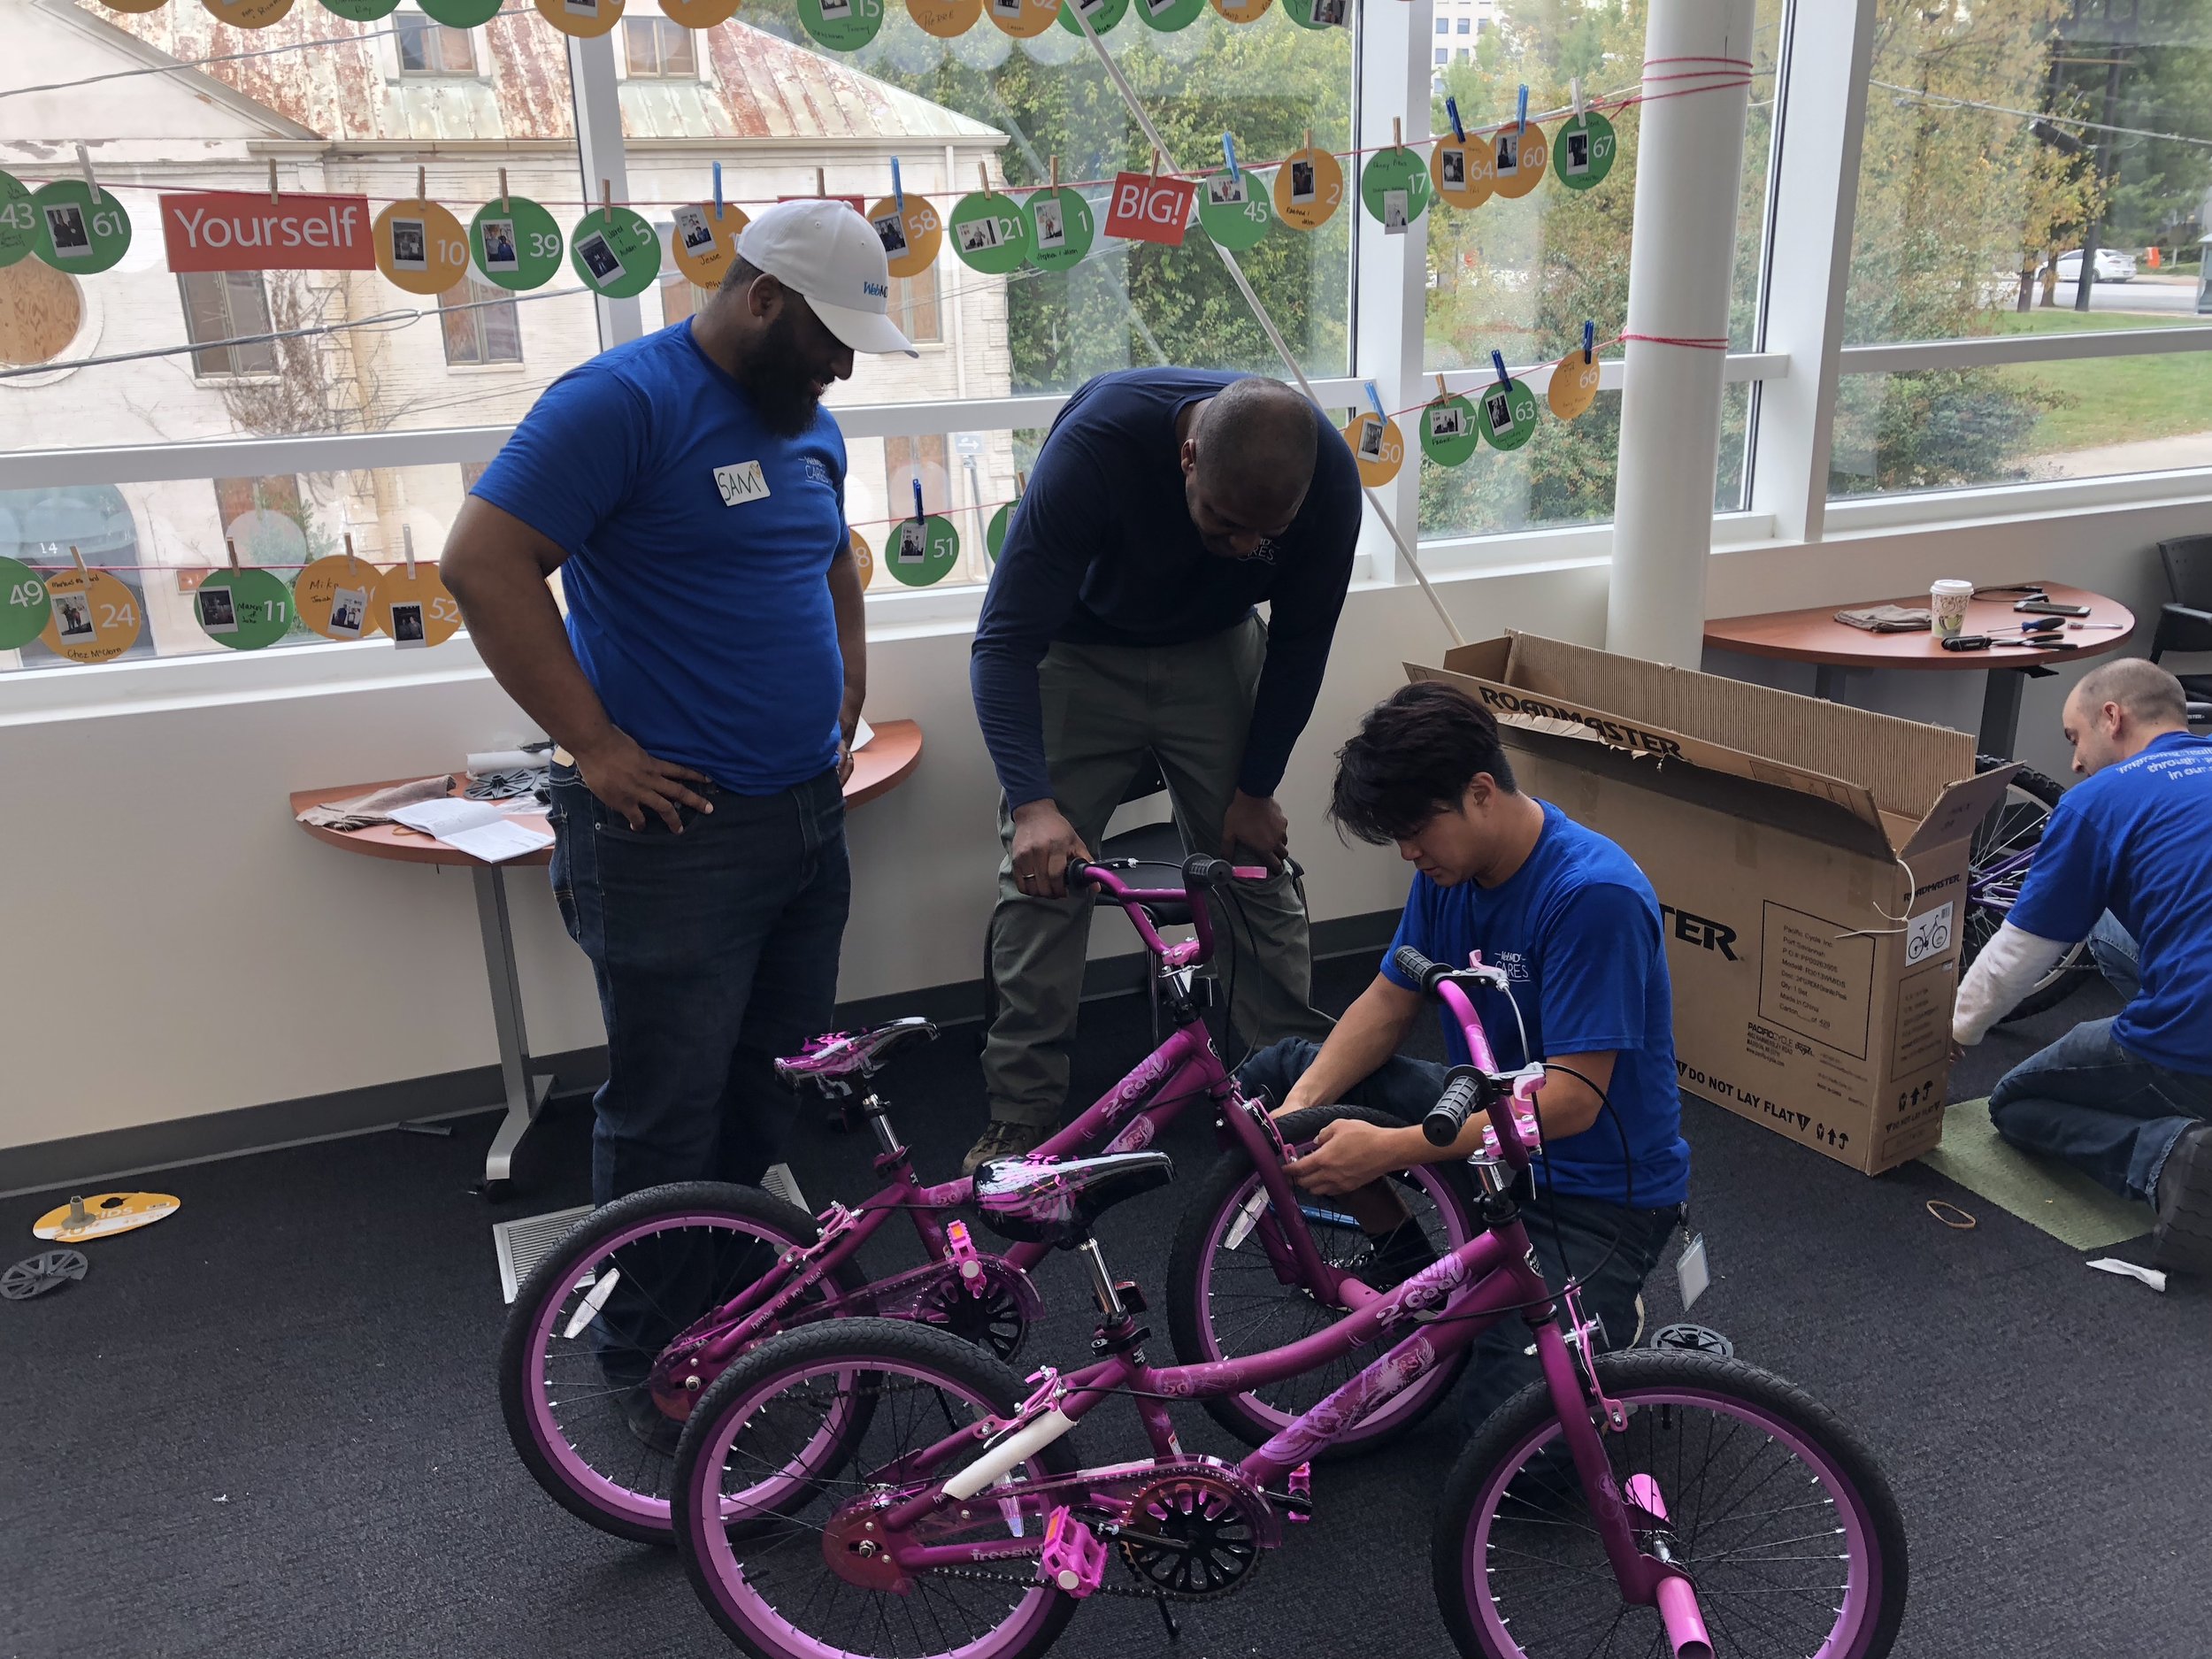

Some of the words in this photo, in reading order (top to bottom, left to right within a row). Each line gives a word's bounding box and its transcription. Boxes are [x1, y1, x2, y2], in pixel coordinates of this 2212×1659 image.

[1523, 146, 1544, 168] 60
[1594, 135, 1613, 157] 67
[1471, 160, 1494, 180] 64
[1326, 183, 1340, 204] 2
[1408, 173, 1426, 194] 17
[0, 203, 35, 229] 43
[1117, 184, 1184, 226] BIG!
[1244, 200, 1267, 223] 45
[93, 211, 123, 237] 61
[173, 206, 357, 248] Yourself
[632, 220, 652, 246] 5
[908, 209, 937, 239] 58
[999, 216, 1024, 241] 21
[1078, 211, 1088, 233] 1
[437, 239, 466, 266] 10
[529, 233, 560, 258] 39
[1579, 365, 1598, 388] 66
[1515, 401, 1534, 421] 63
[1379, 442, 1401, 465] 50
[718, 470, 762, 501] SAM
[805, 465, 830, 484] CARES
[933, 537, 954, 558] 51
[9, 580, 43, 608] 49
[100, 603, 135, 628] 24
[264, 600, 285, 623] 11
[429, 597, 457, 623] 52
[1479, 687, 1686, 759] ROADMASTER
[1903, 873, 1960, 902] RADMASTER
[1689, 1067, 1705, 1084] DO
[1709, 1076, 1733, 1096] NOT
[1737, 1088, 1761, 1109] LAY
[1763, 1101, 1795, 1125] FLAT
[96, 1206, 134, 1220] IDS
[750, 1310, 775, 1330] hands
[777, 1295, 788, 1309] off
[790, 1286, 804, 1299] my
[971, 1544, 1044, 1562] freestyl
